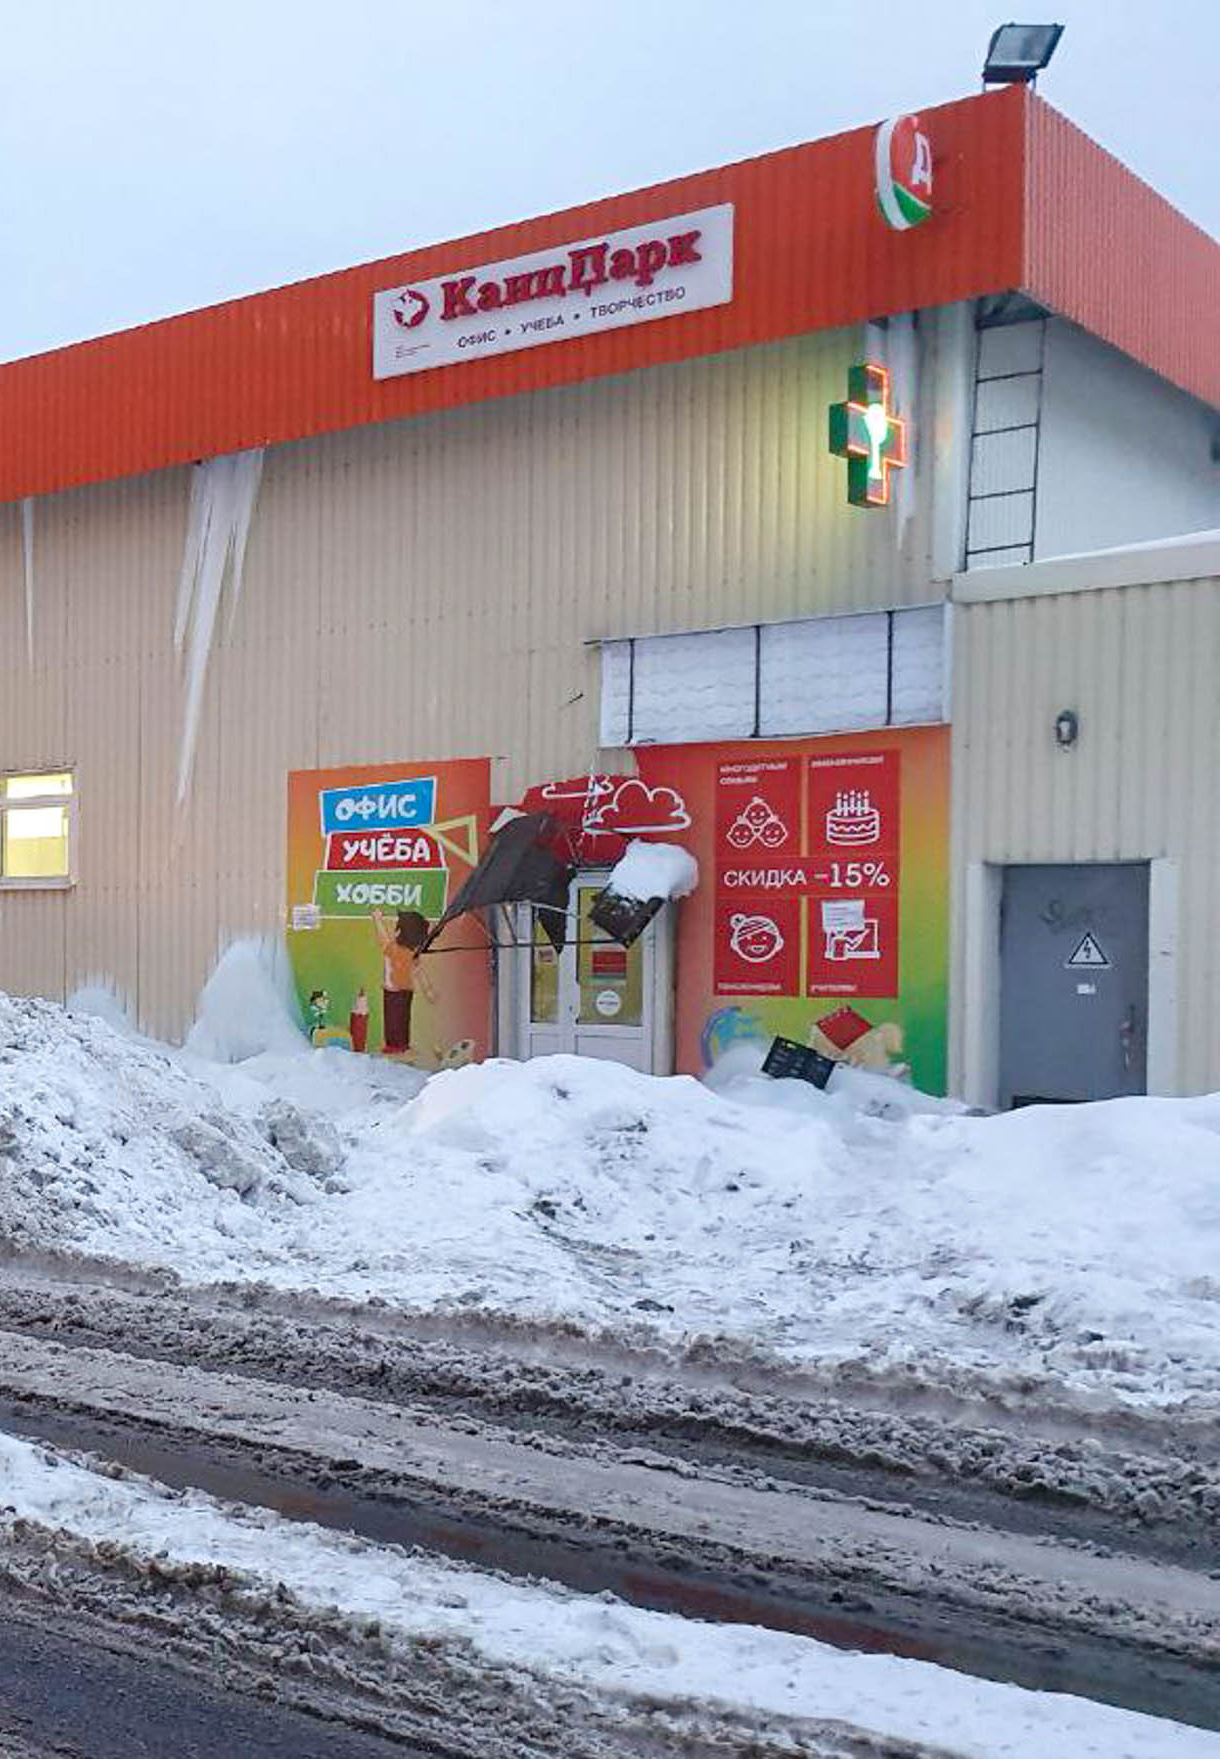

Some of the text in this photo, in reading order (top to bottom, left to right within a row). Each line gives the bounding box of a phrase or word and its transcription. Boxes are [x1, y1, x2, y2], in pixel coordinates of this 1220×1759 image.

[456, 329, 497, 349] ОФИС
[589, 285, 687, 319] ТВОРЧЕСТВО
[334, 794, 417, 821] ОФИС
[342, 832, 431, 863] УЧЁБА
[723, 860, 890, 889] СКИДКА -15%
[335, 882, 423, 906] ХОББИ
